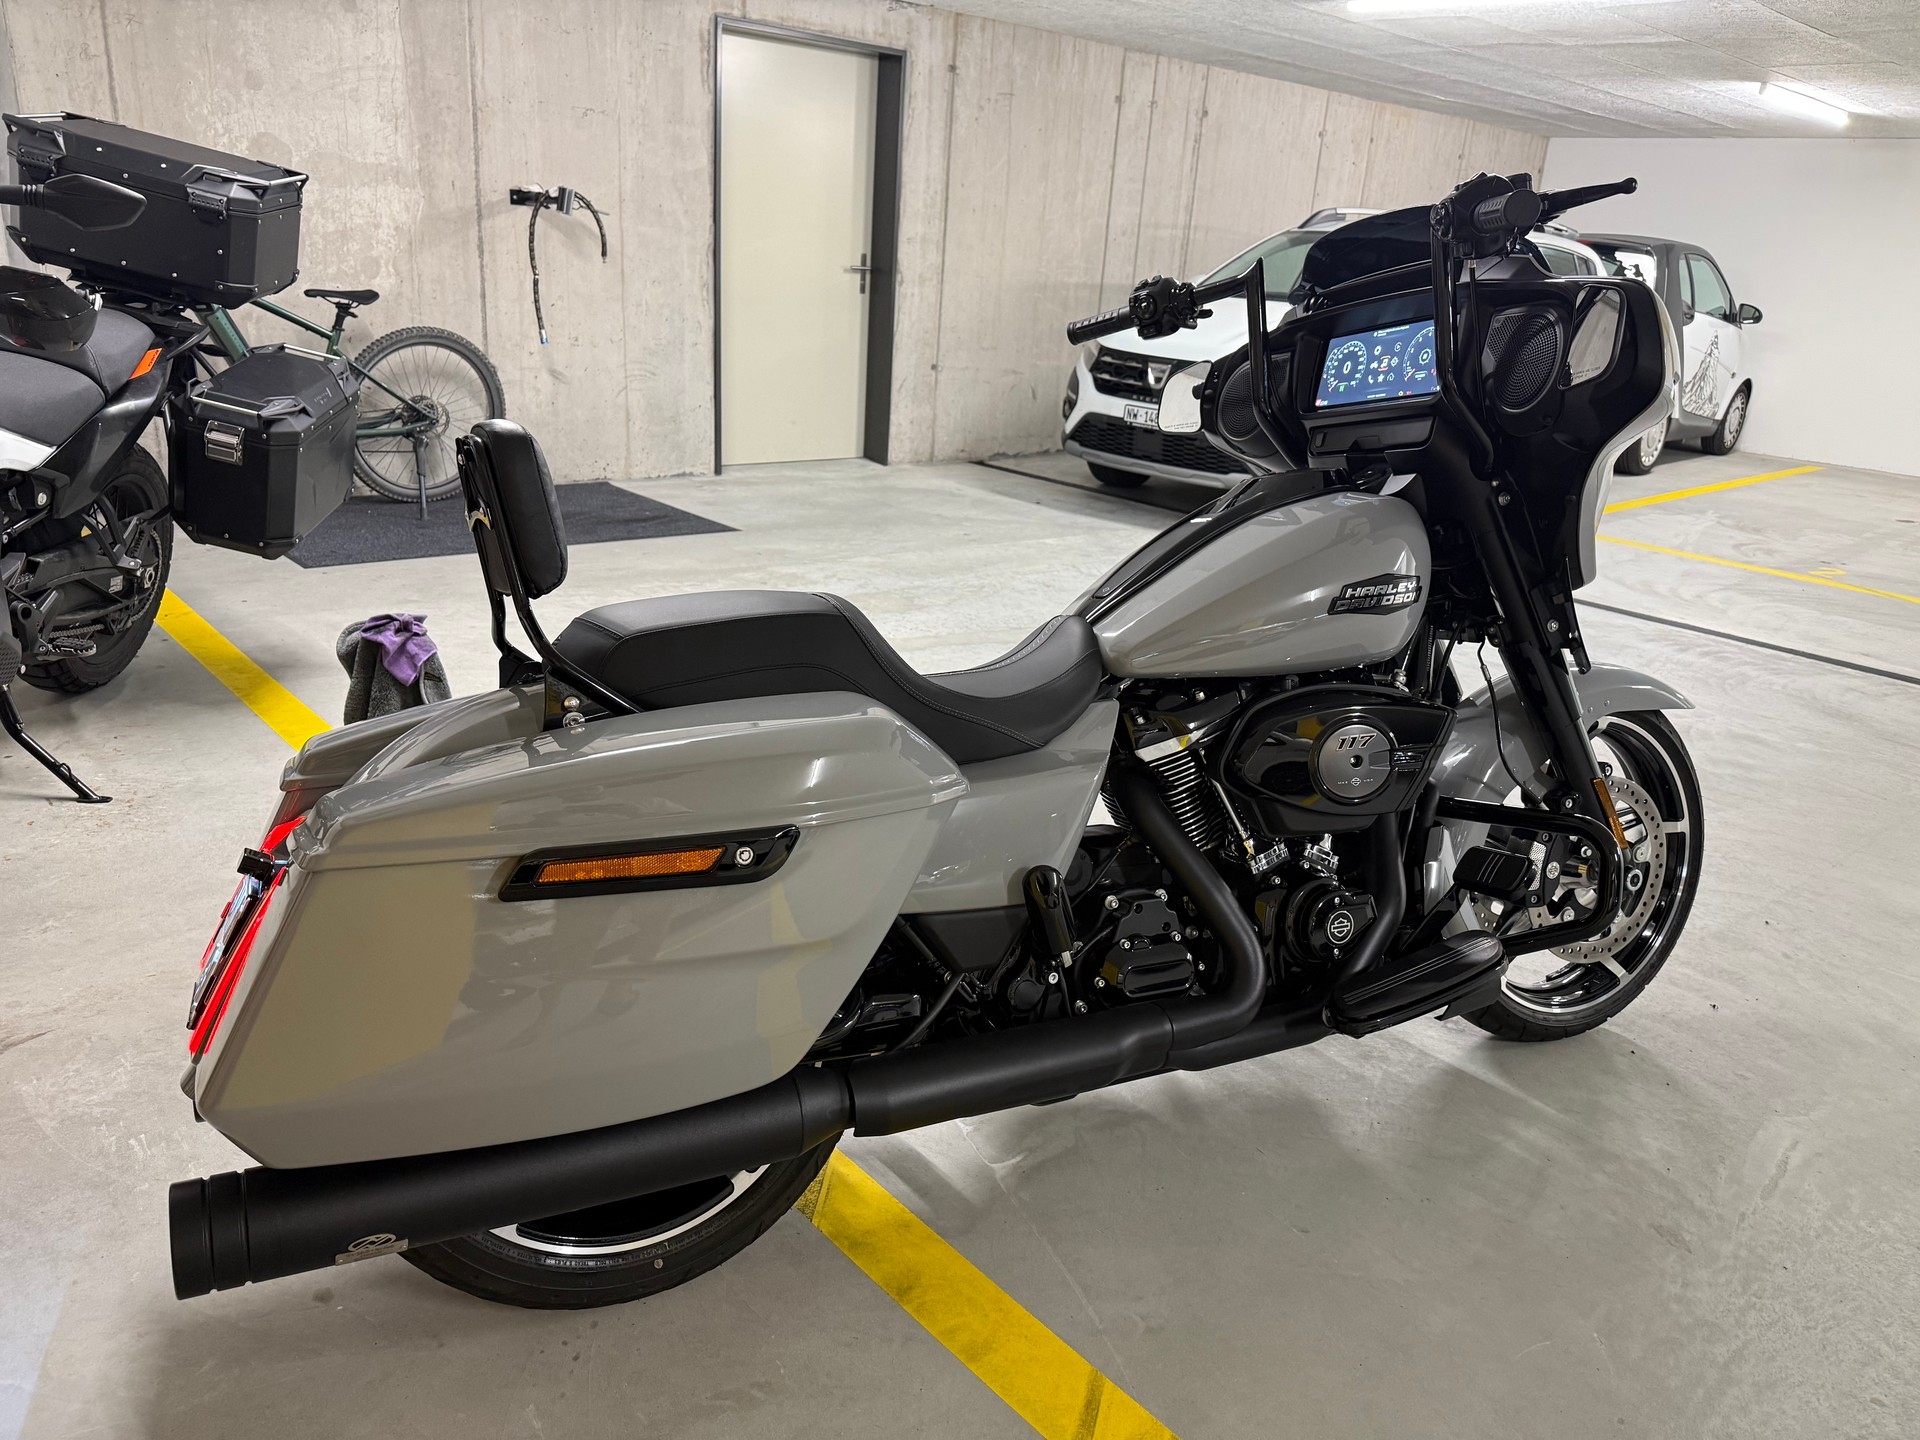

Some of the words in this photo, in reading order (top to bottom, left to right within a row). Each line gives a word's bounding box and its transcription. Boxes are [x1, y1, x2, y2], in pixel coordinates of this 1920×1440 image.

[1343, 361, 1351, 374] 0
[1126, 407, 1138, 420] NW
[1334, 591, 1419, 611] DAVIDSON
[1336, 732, 1377, 751] 117
